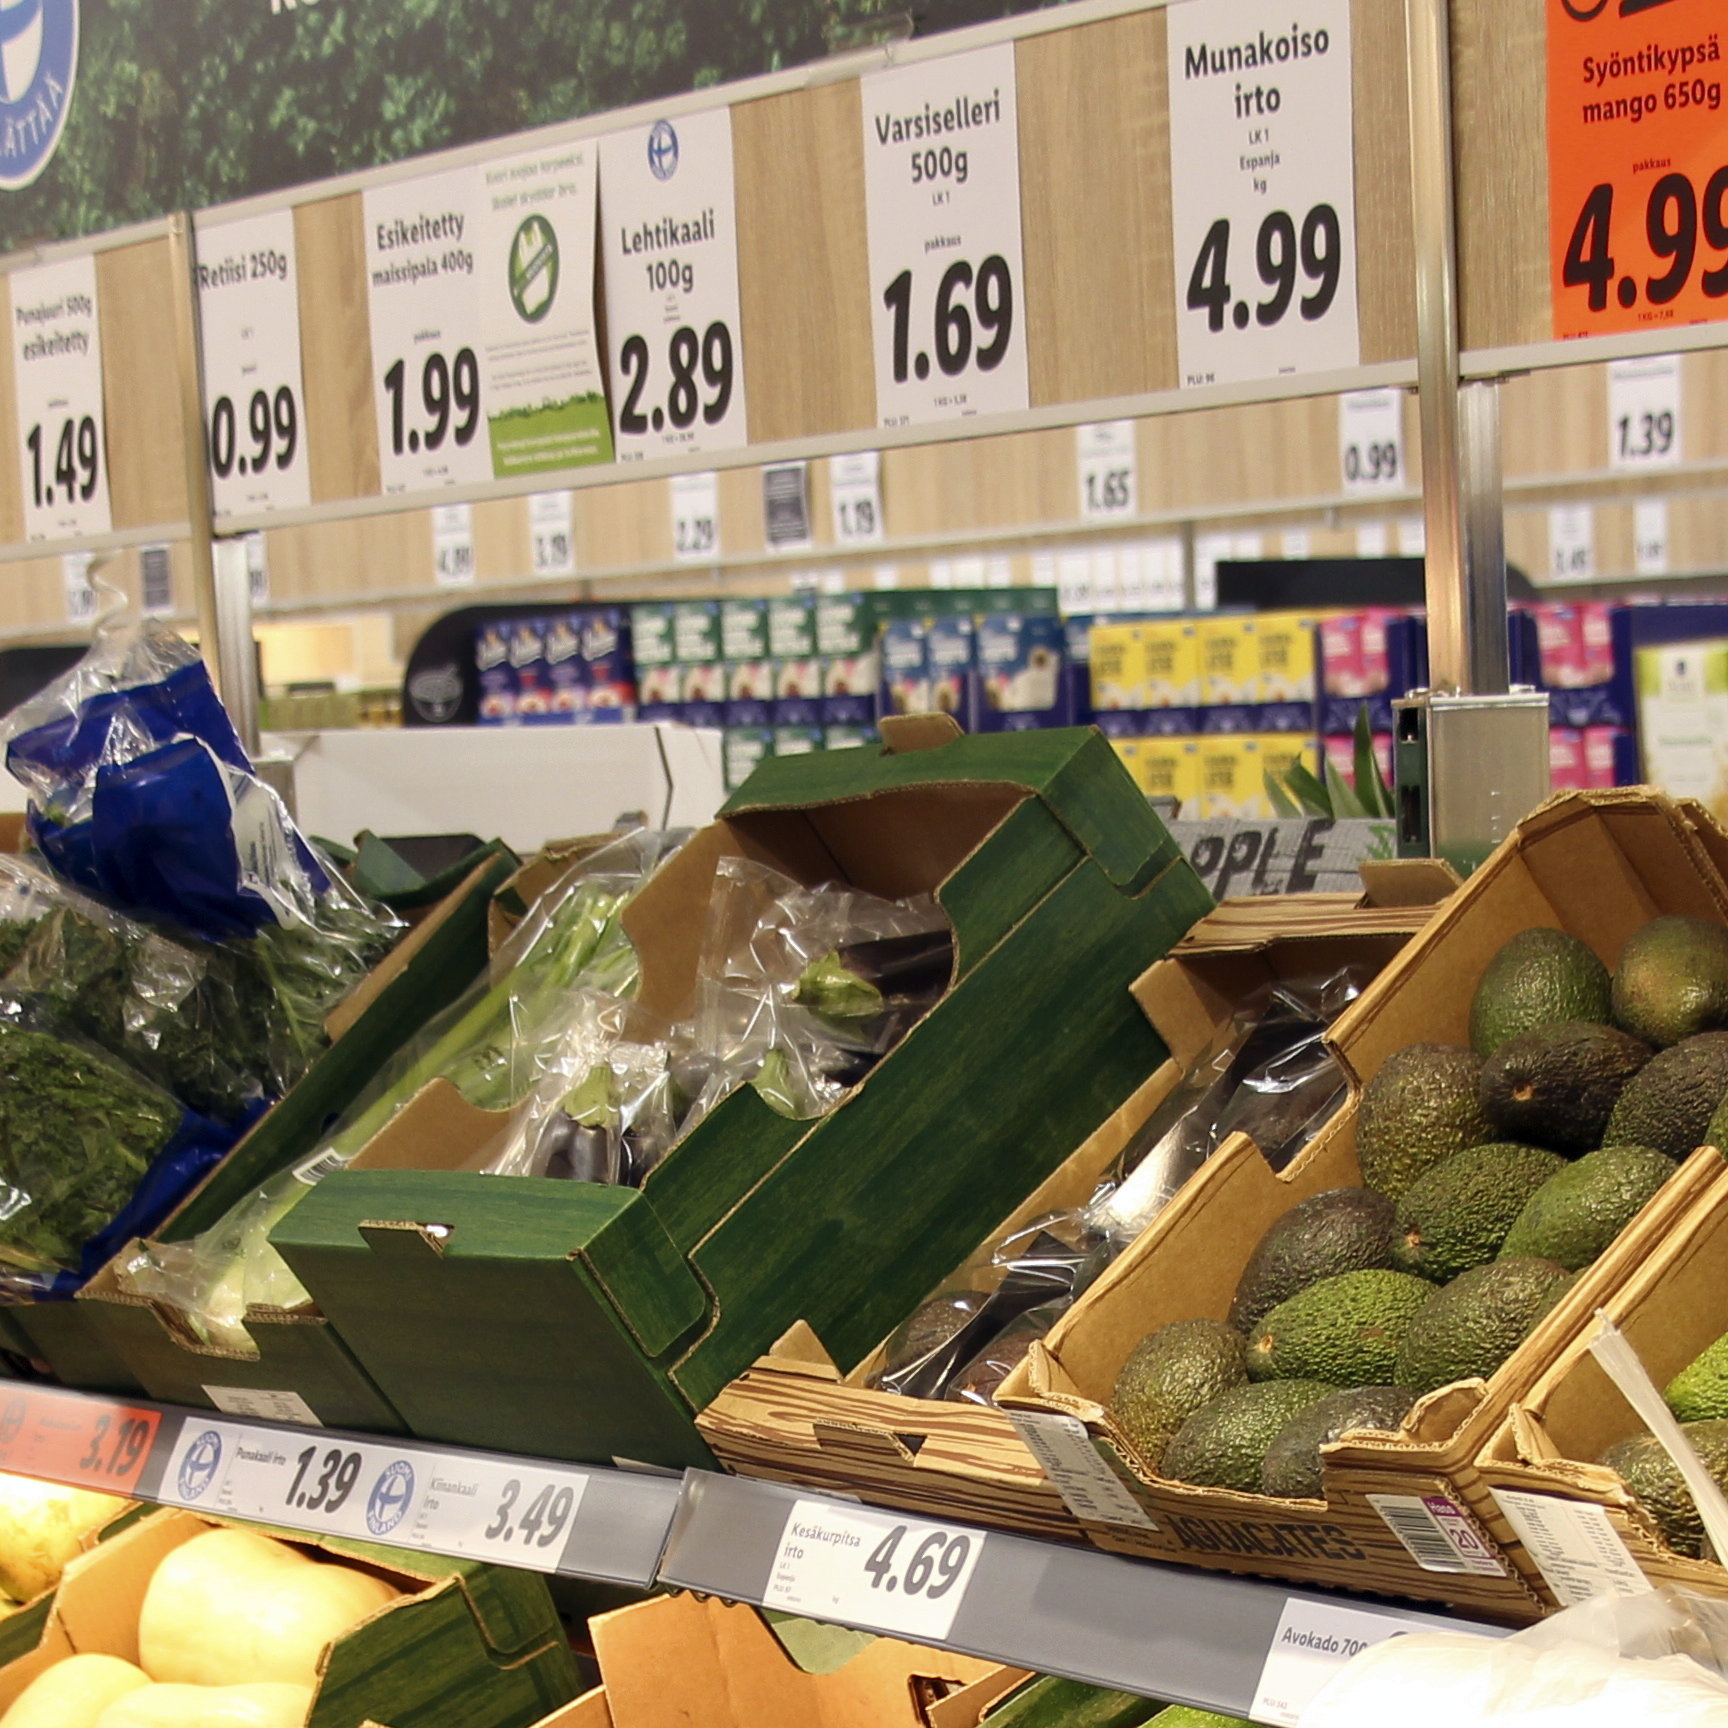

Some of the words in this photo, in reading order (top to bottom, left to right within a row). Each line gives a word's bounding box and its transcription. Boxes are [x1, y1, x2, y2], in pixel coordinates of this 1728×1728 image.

[1185, 22, 1329, 80] Munakoiso
[1583, 34, 1720, 88] Syöntikypsä
[876, 89, 1000, 147] Varsiselleri
[1235, 83, 1281, 119] irto
[1583, 91, 1656, 125] mango
[1664, 79, 1721, 111] 650g
[1249, 130, 1262, 146] LK
[911, 149, 968, 184] 500g
[1239, 150, 1280, 172] Espanja
[1633, 157, 1671, 174] pakkaus
[1253, 176, 1266, 194] kg
[377, 213, 464, 251] Esikeitetty
[621, 208, 715, 255] Lehtikaali
[924, 234, 961, 252] pakkaus
[200, 258, 247, 289] Retiisi
[250, 253, 287, 281] 250g
[373, 260, 438, 287] maissipala
[440, 250, 472, 275] 400g
[646, 258, 693, 294] 100g
[1187, 203, 1341, 333] 4.99
[884, 254, 1012, 383] 1.69
[23, 330, 89, 361] esikeitetty
[620, 320, 733, 434] 2.89
[384, 346, 479, 455] 1.99
[212, 385, 296, 479] 0.99
[1618, 410, 1674, 459] 1.39
[28, 415, 97, 507] 1.49
[1346, 441, 1397, 483] 0.99
[79, 1415, 150, 1477] 3.19
[236, 1447, 271, 1464] Punakaali
[272, 1452, 287, 1465] irto
[286, 1445, 362, 1513] 1.39
[430, 1477, 479, 1497] Kiinankaali
[423, 1495, 440, 1510] irto
[485, 1479, 574, 1548] 3.49
[367, 1509, 404, 1534] FINLAND
[791, 1523, 861, 1548] Kesäkurpitsa
[1174, 1516, 1368, 1562] AGUACATES
[1449, 1528, 1479, 1550] 20
[784, 1542, 804, 1559] irto
[864, 1525, 971, 1599] 4.69
[1282, 1626, 1340, 1656] Avokado
